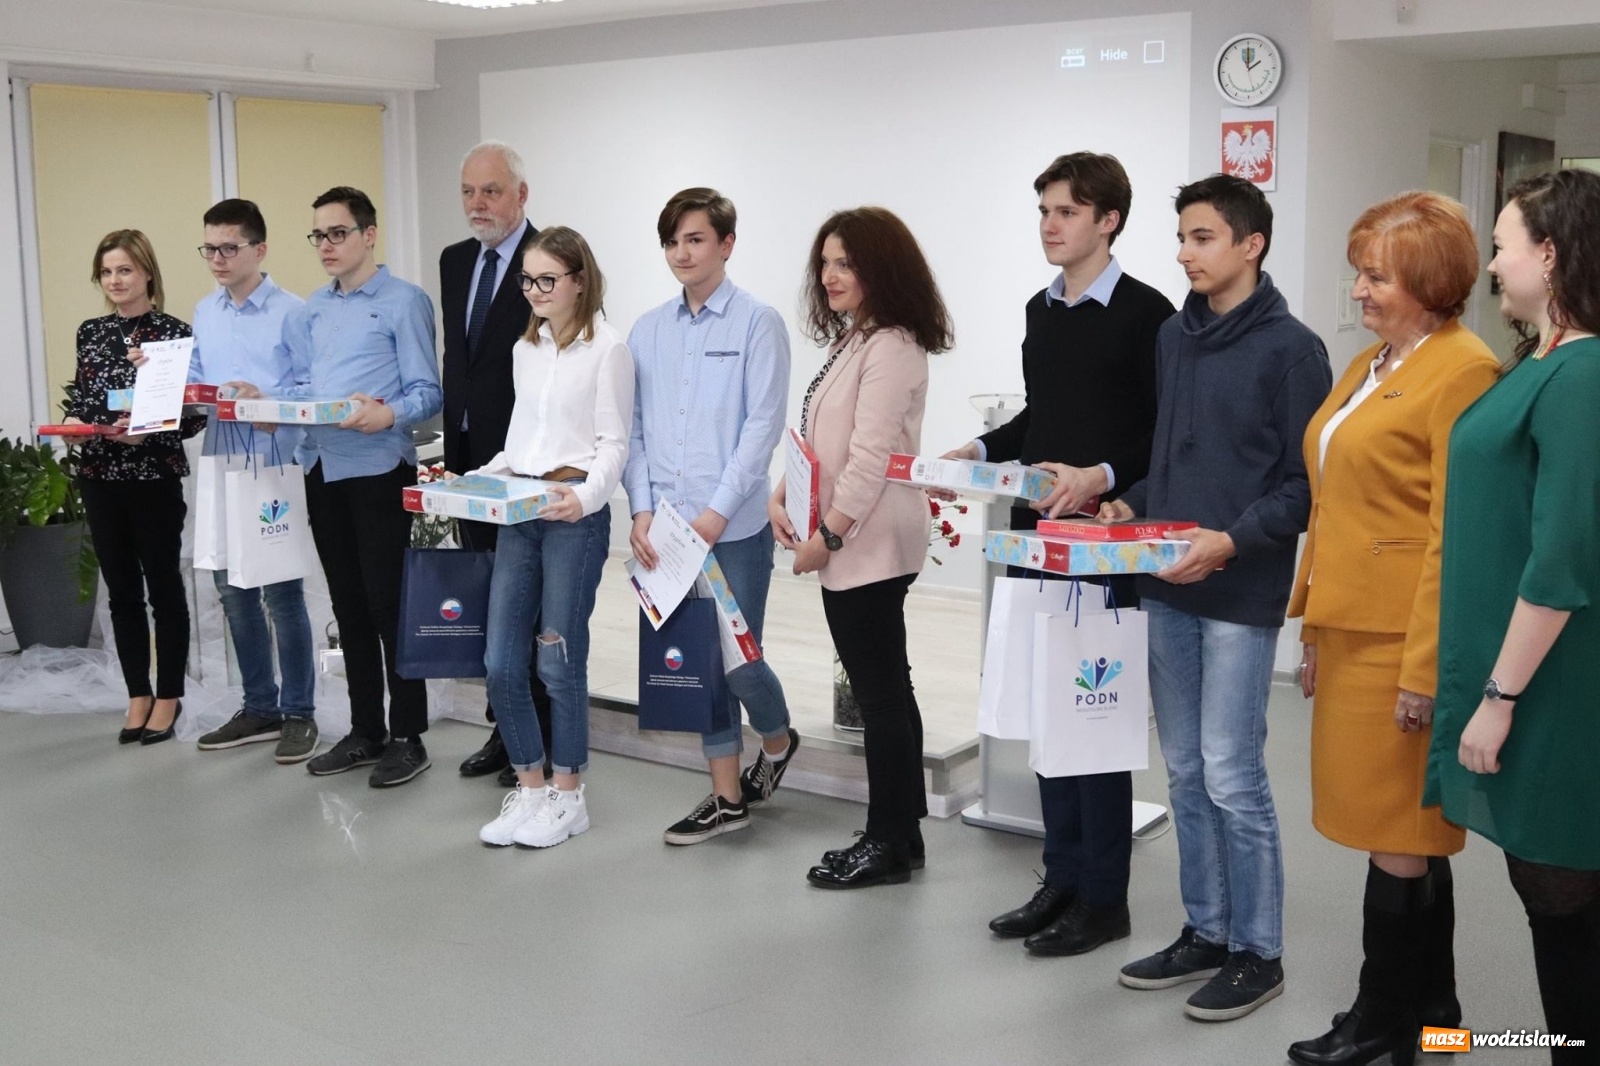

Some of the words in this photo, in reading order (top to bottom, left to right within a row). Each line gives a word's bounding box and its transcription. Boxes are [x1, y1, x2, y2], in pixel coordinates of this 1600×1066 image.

[1100, 48, 1128, 61] Hide
[260, 523, 289, 536] PODN
[1135, 526, 1158, 536] POLSKA
[1075, 691, 1118, 706] PODN
